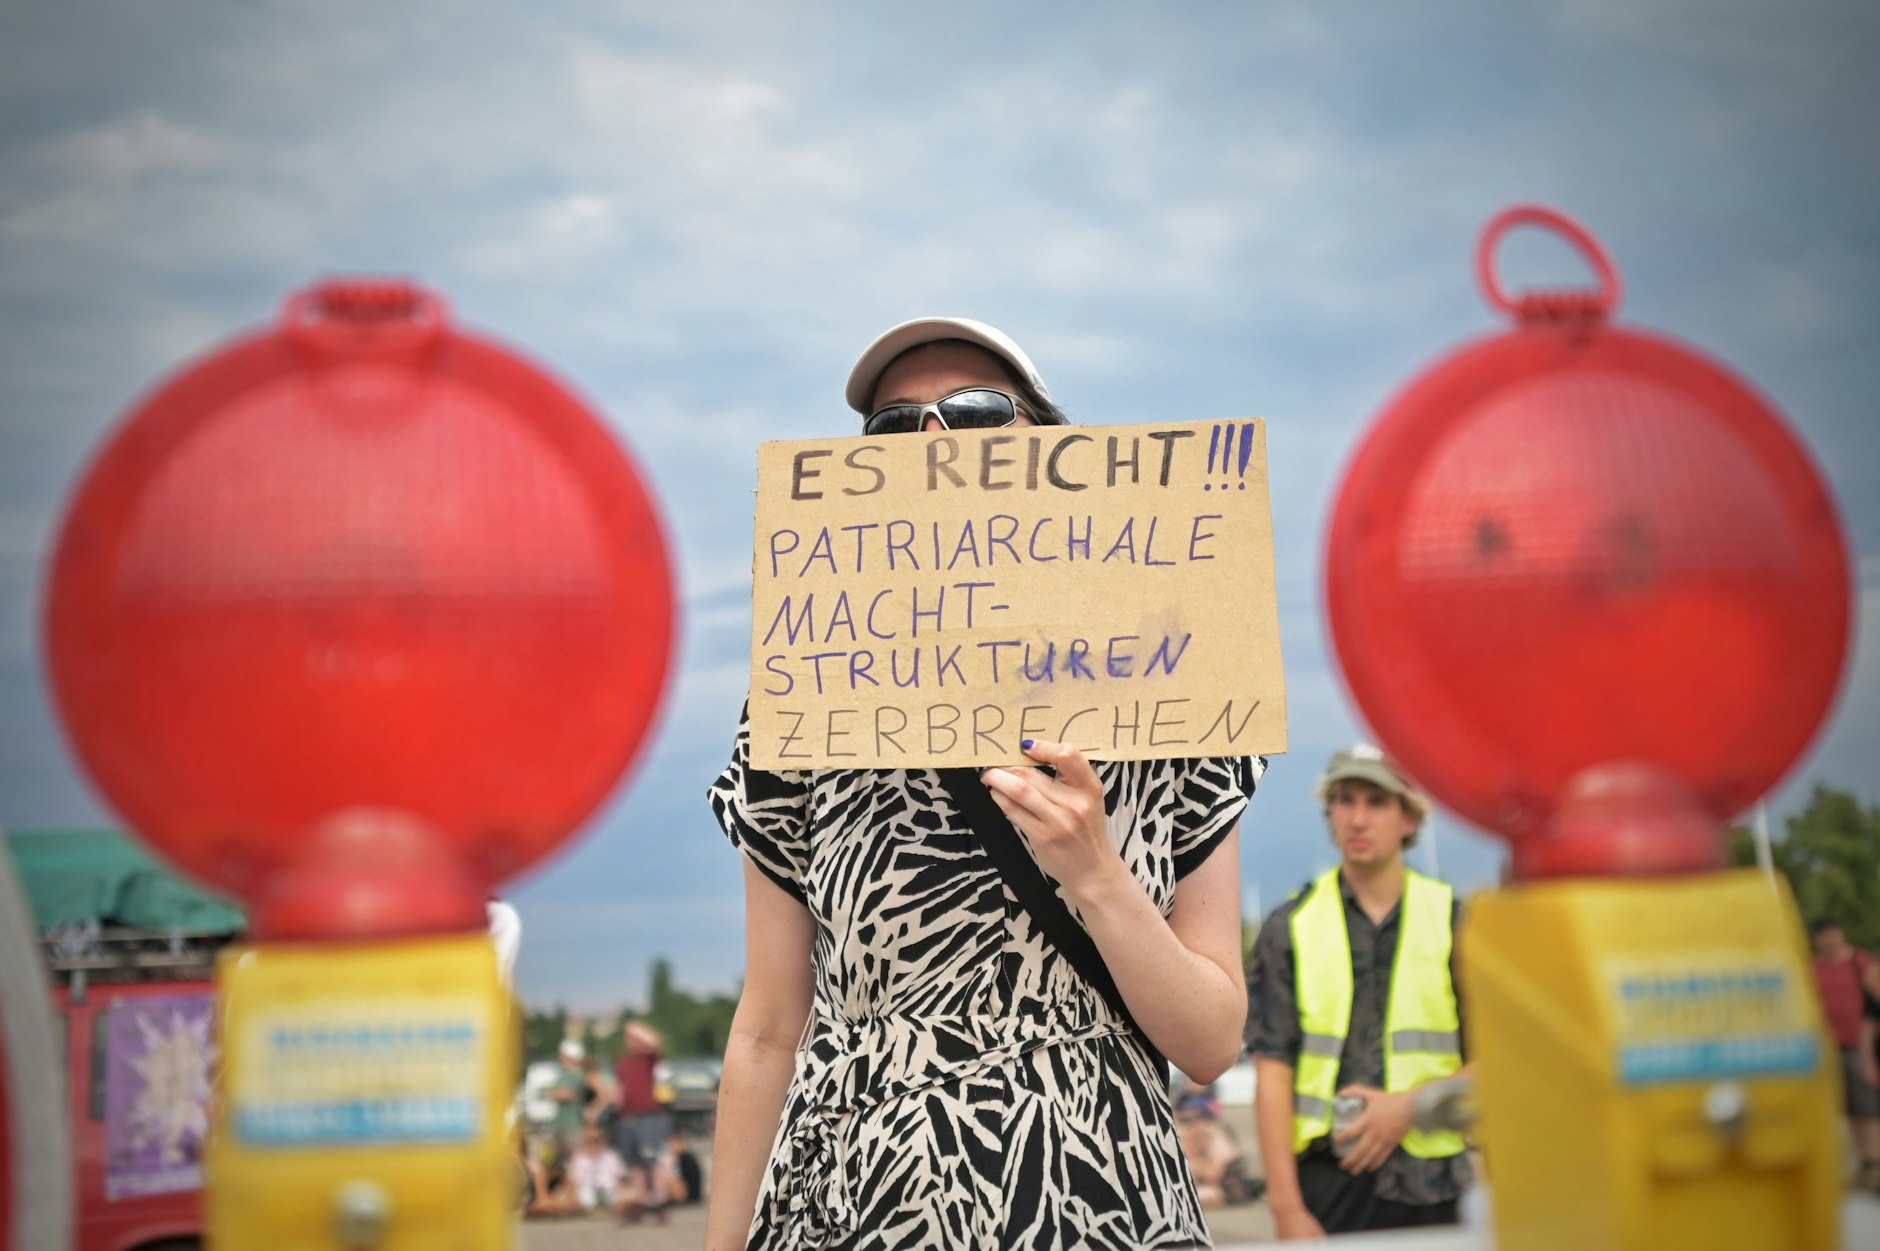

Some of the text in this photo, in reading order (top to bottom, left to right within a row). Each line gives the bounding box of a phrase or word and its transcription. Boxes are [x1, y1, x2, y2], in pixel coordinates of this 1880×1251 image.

[790, 423, 1255, 500] ES REICHT!!!
[769, 514, 1223, 577] PATRIARCHALE
[762, 582, 1010, 646] MACHT-
[763, 632, 1192, 696] STRUKTUREN
[776, 698, 1261, 759] ZERBRECHEN
